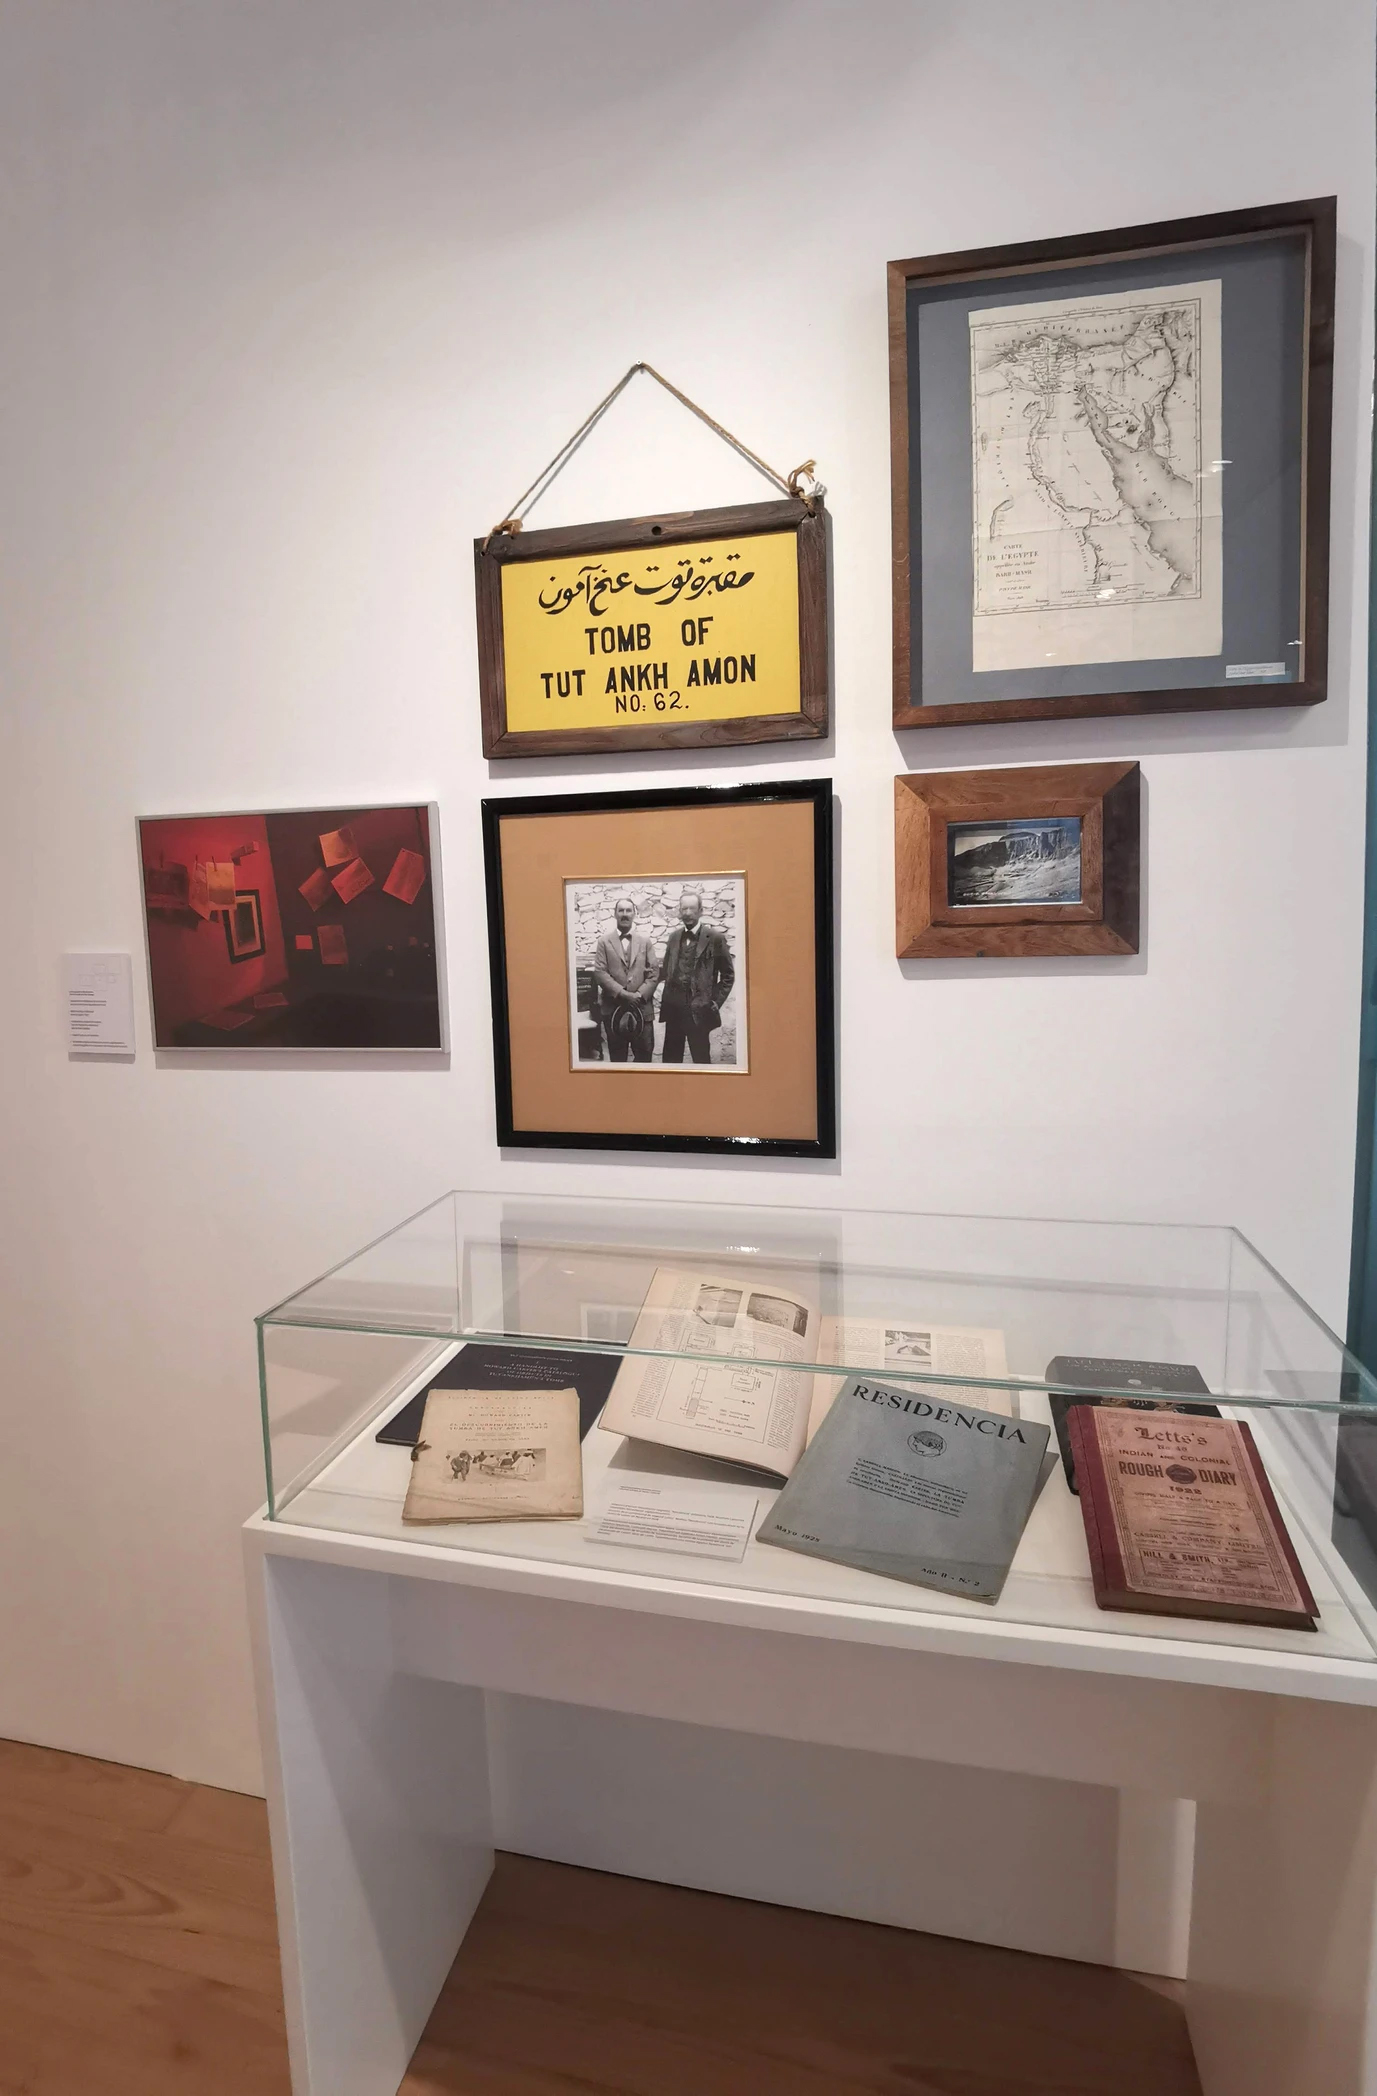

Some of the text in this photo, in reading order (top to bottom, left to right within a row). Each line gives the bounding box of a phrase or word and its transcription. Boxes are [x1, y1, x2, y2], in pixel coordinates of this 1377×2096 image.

[585, 616, 714, 655] TOMB OF
[540, 654, 756, 699] TUT ANKH AMON
[852, 1384, 1028, 1444] RESIDENCIA
[1118, 1461, 1238, 1486] ROUGH DIARY
[1119, 1449, 1154, 1458] INDIAN
[1180, 1455, 1231, 1466] COLONIAL
